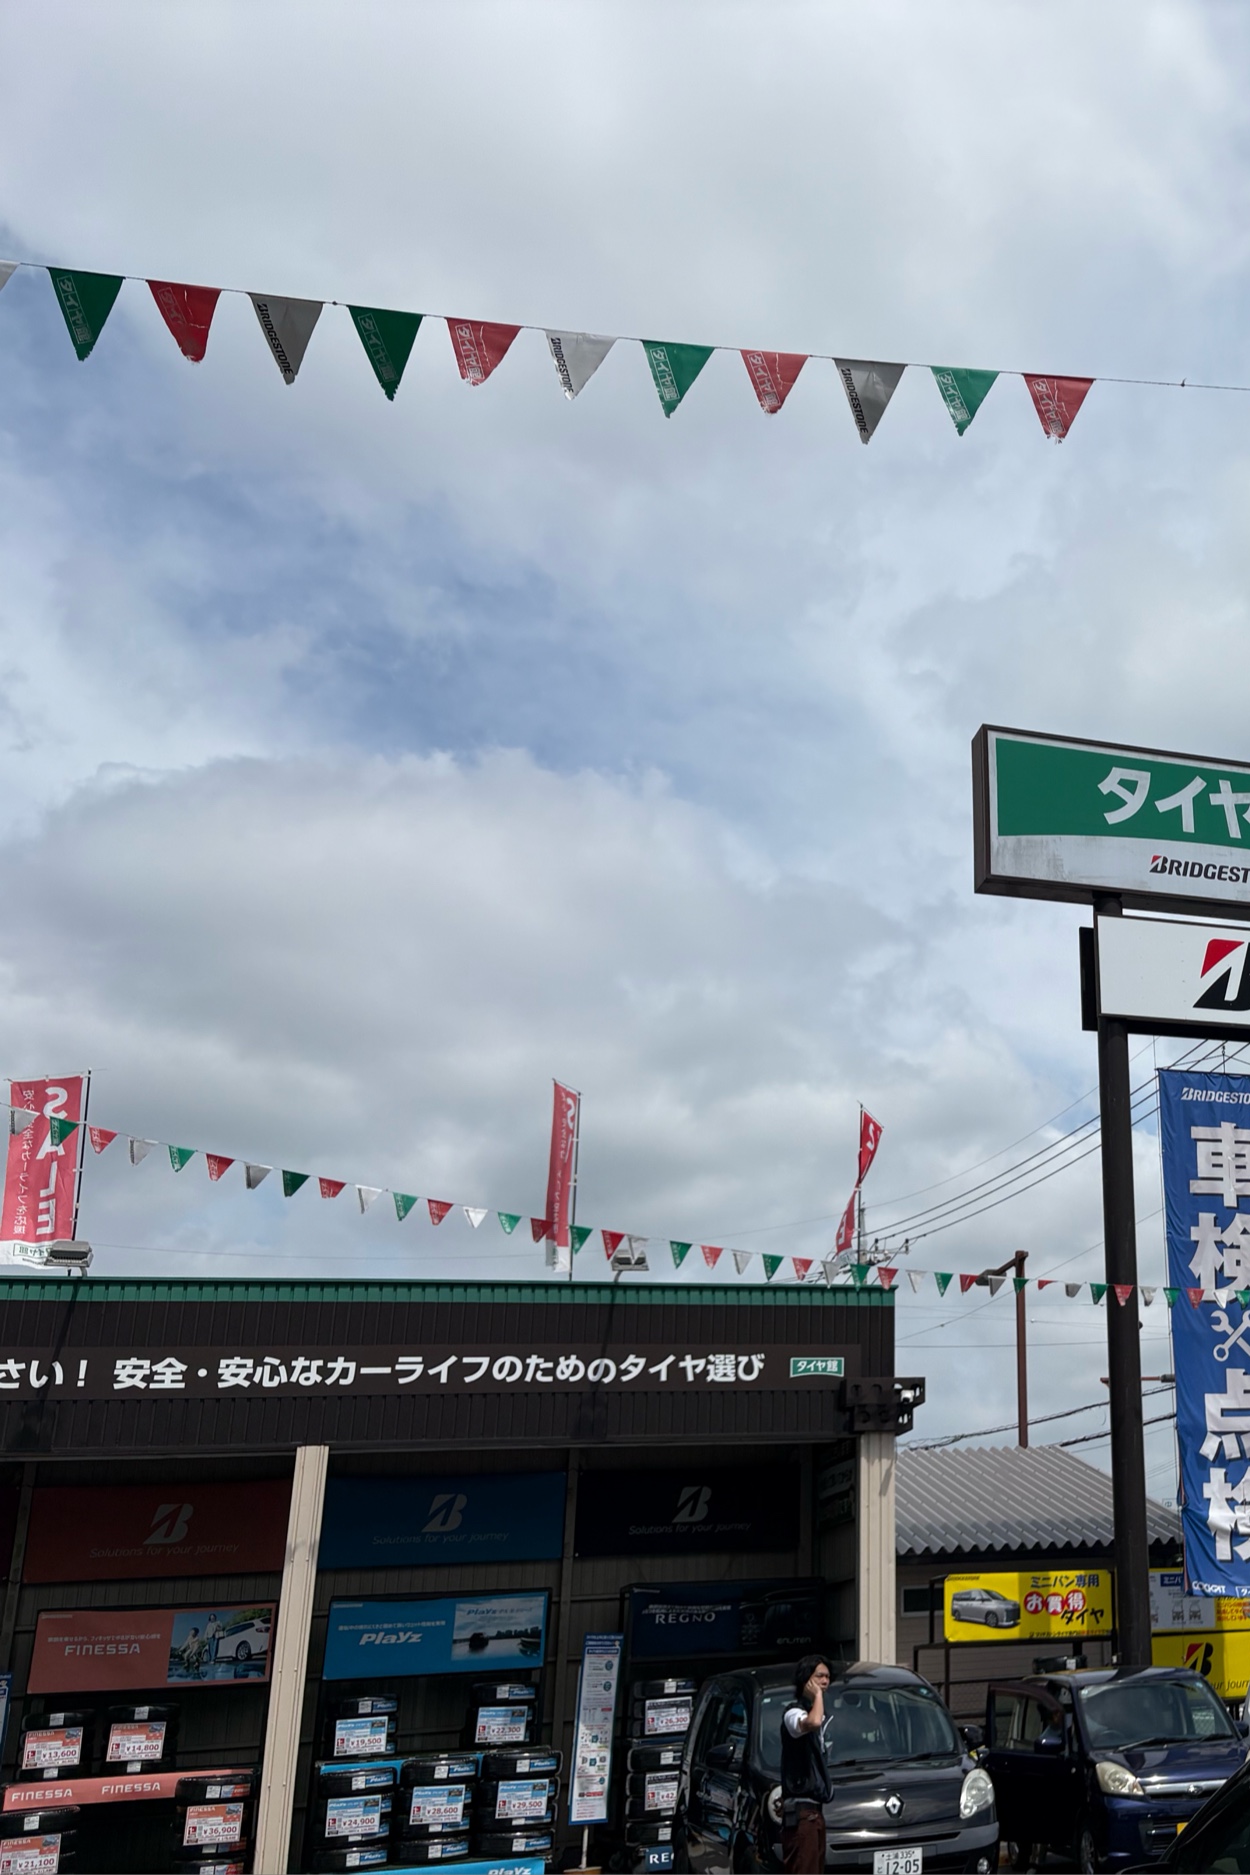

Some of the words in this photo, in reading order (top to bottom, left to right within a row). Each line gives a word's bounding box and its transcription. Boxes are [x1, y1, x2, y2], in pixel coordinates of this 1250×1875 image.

[256, 303, 293, 375] BRIDGESTONE
[551, 337, 574, 393] BRIDGESTONE
[841, 368, 869, 434] BRIDGESTONE
[113, 1353, 765, 1389] 安全・安心なカーライフのためのタイヤ選び
[797, 1357, 839, 1373] タイヤ館
[628, 1523, 674, 1536] Solutions
[675, 1522, 691, 1533] for
[692, 1524, 713, 1536] your
[373, 1534, 421, 1545] Solutions
[424, 1532, 440, 1543] for
[442, 1532, 465, 1545] your
[90, 1546, 145, 1558] Solutions
[147, 1545, 163, 1556] for
[165, 1544, 193, 1558] your
[1030, 1574, 1100, 1588] ミニバン専用
[1025, 1592, 1085, 1615] お買得
[655, 1612, 717, 1625] REGNO
[1060, 1609, 1105, 1626] タイヤ
[64, 1643, 141, 1657] FINESSA
[42, 1749, 77, 1759] ¥13,600
[126, 1744, 159, 1752] ¥14,800
[11, 1788, 72, 1802] FINESSA
[101, 1782, 161, 1795] FINESSA
[203, 1825, 237, 1835] ¥36,900
